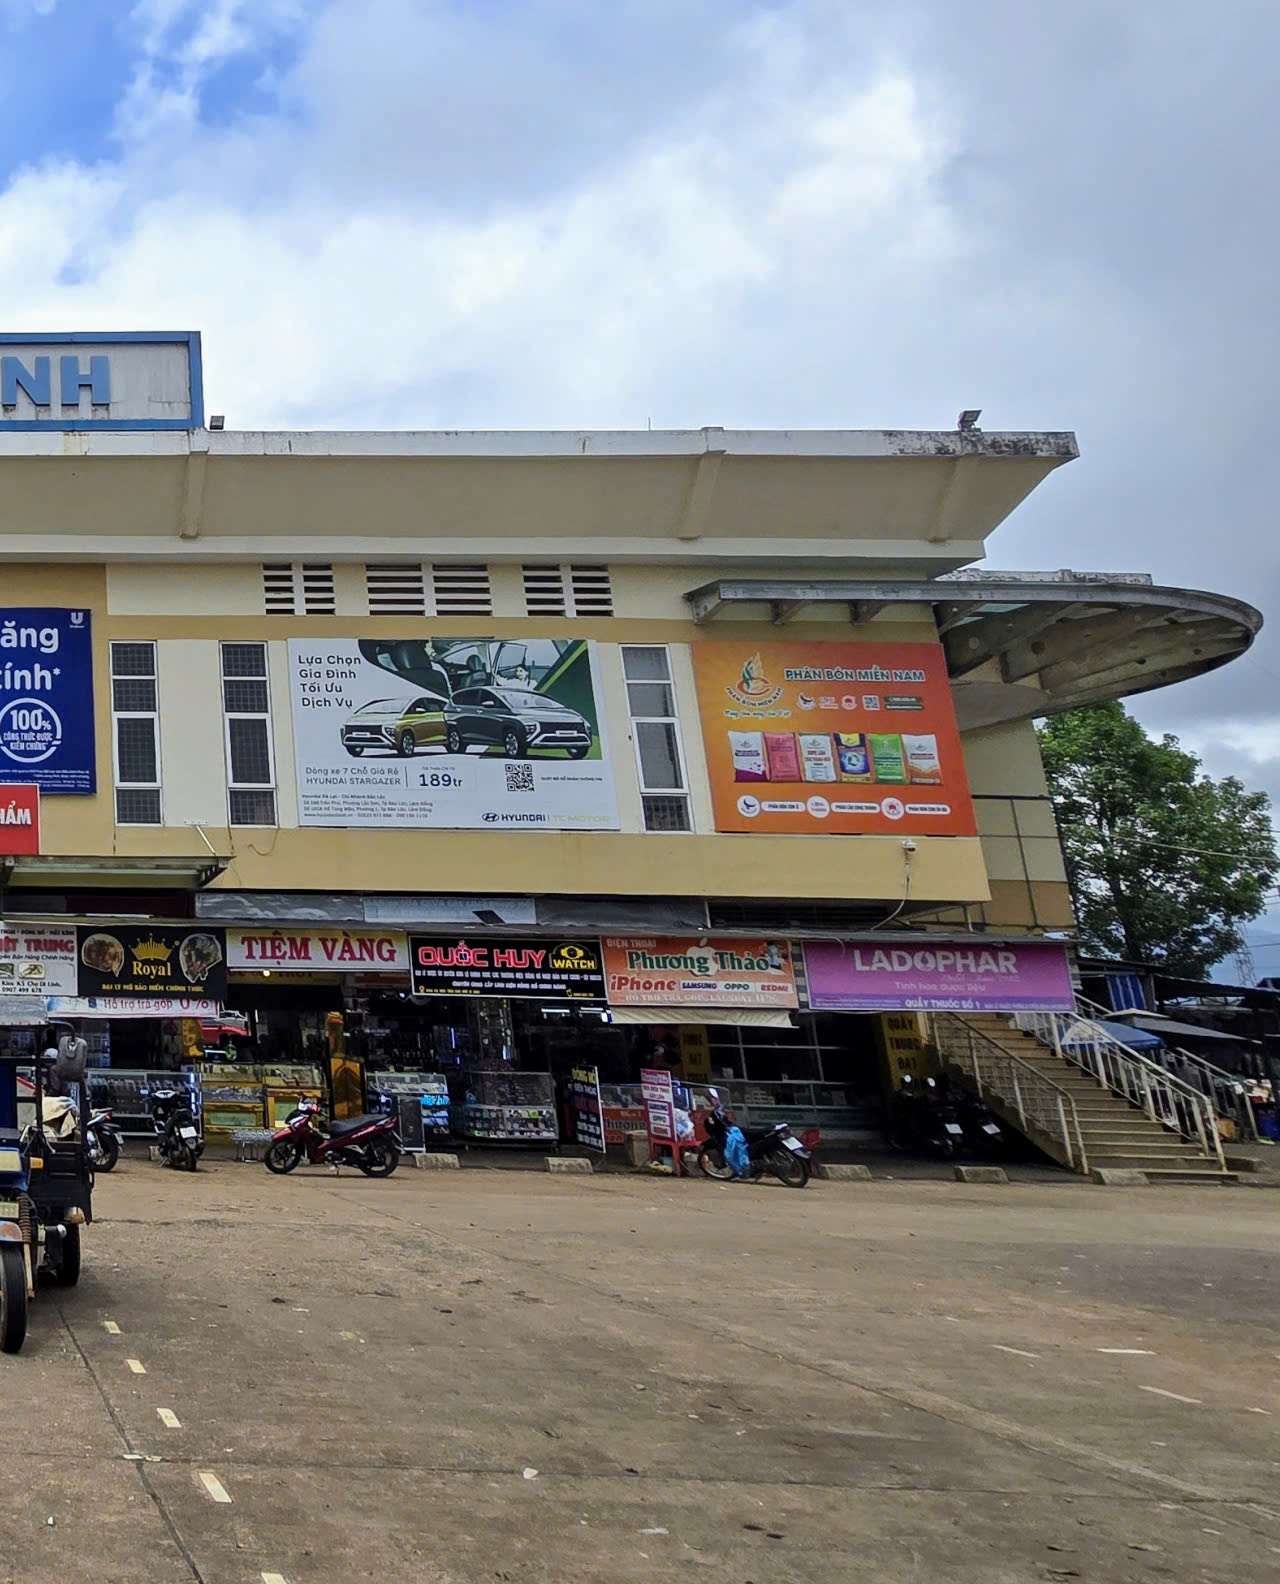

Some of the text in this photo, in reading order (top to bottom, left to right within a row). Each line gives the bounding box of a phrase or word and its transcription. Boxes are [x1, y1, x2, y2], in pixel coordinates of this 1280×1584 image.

[298, 655, 361, 666] Lựa Chọn
[299, 668, 357, 679] Gia Đình
[784, 664, 925, 682] PHÂN BÓN MIỀN NAM
[300, 681, 343, 692] Tối Ưu
[302, 697, 353, 709] Dịch Vụ
[10, 708, 52, 730] 100%
[305, 767, 328, 776] Dòng
[343, 767, 348, 775] 7
[306, 777, 401, 785] HYUNDAI STARGAZER
[501, 814, 546, 822] HYUNDAI
[23, 937, 75, 953] TRUNG
[241, 930, 397, 965] TIỆM VÀNG
[606, 938, 657, 949] ĐIỆN THOẠI
[417, 940, 547, 968] QUỐC HUY
[552, 958, 596, 969] WATCH
[626, 949, 770, 974] Phương Thảo
[851, 948, 1019, 975] LADOPHAR
[132, 960, 172, 979] Royal
[609, 974, 677, 992] iPhone
[681, 982, 717, 990] SAMSUNG
[724, 983, 750, 991] OPPO
[760, 984, 789, 992] REDMI
